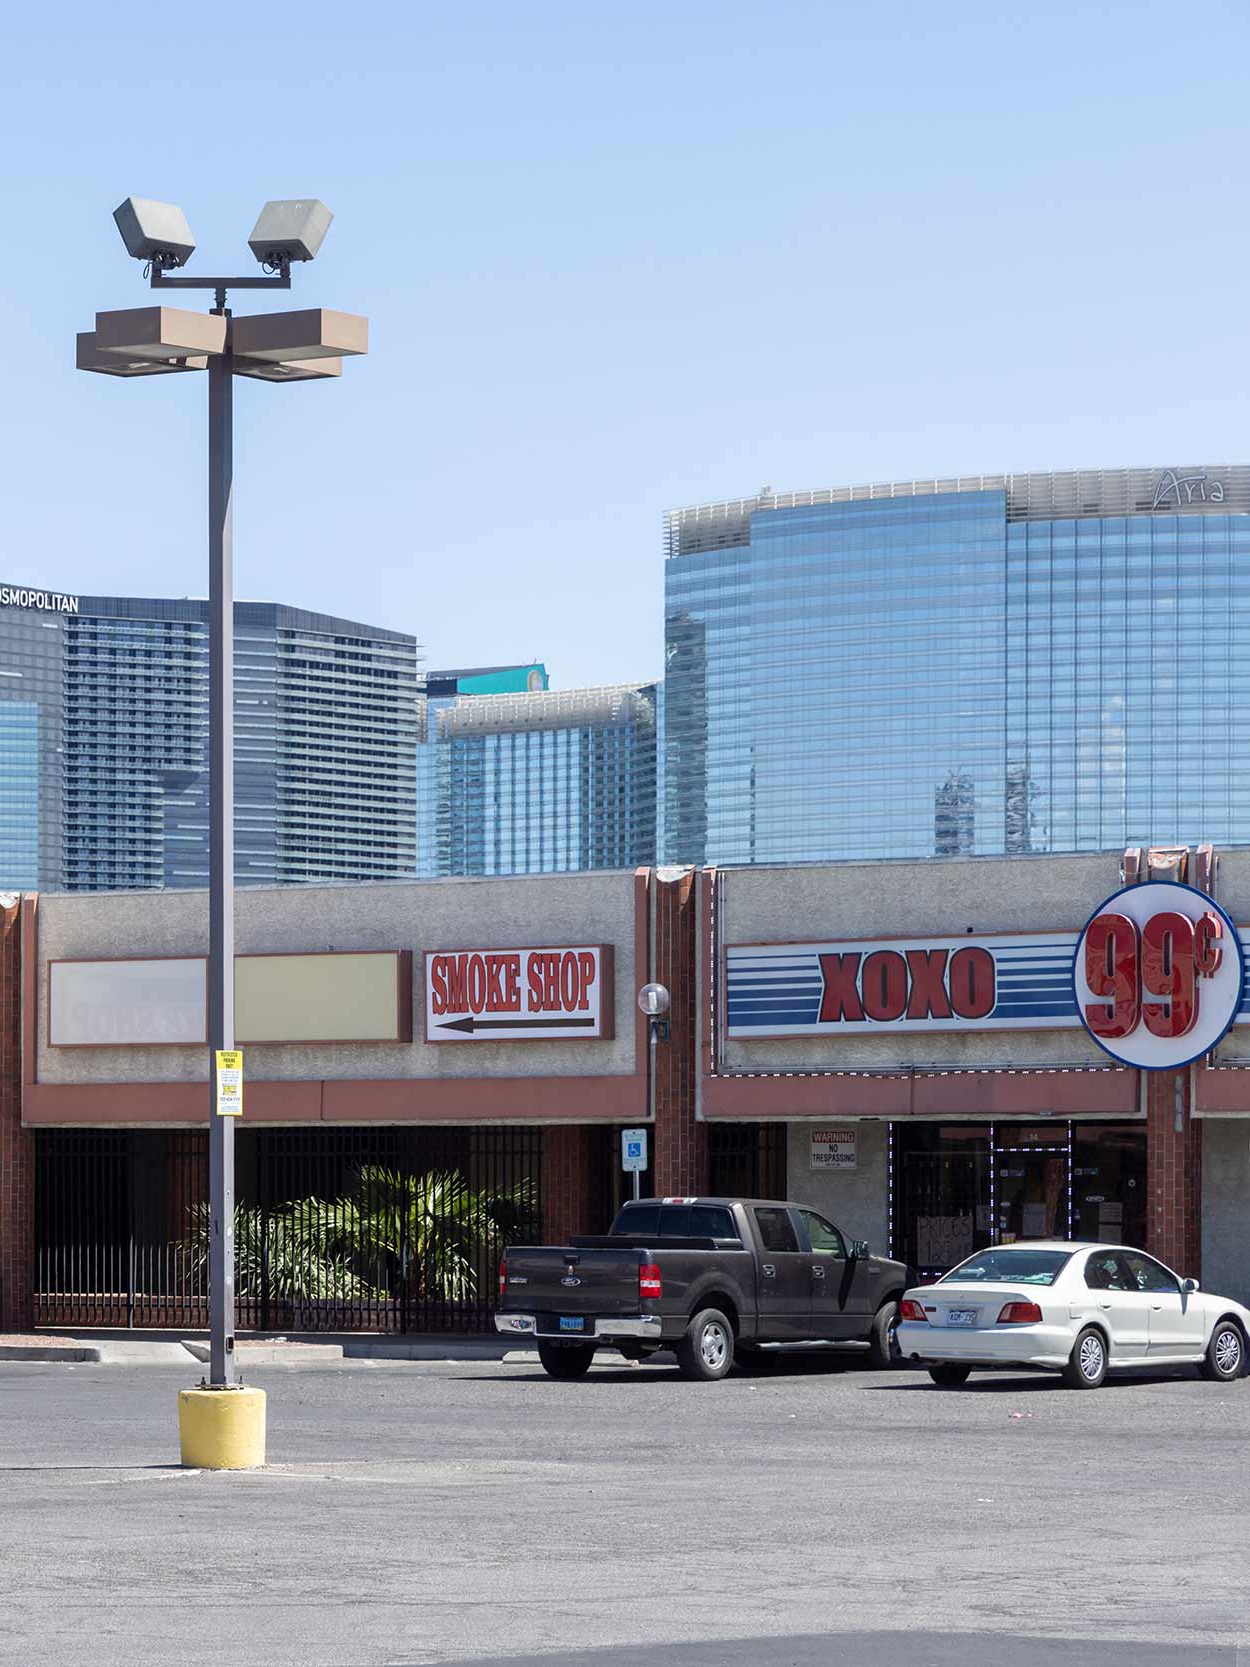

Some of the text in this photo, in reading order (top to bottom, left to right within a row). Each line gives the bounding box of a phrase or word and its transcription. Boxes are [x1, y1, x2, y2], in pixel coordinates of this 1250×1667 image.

[431, 951, 596, 1016] SMOKE SHOP
[818, 946, 997, 1022] XOXO
[813, 1132, 854, 1142] WARNING
[828, 1143, 838, 1152] NO
[813, 1153, 855, 1162] TRESPASSING
